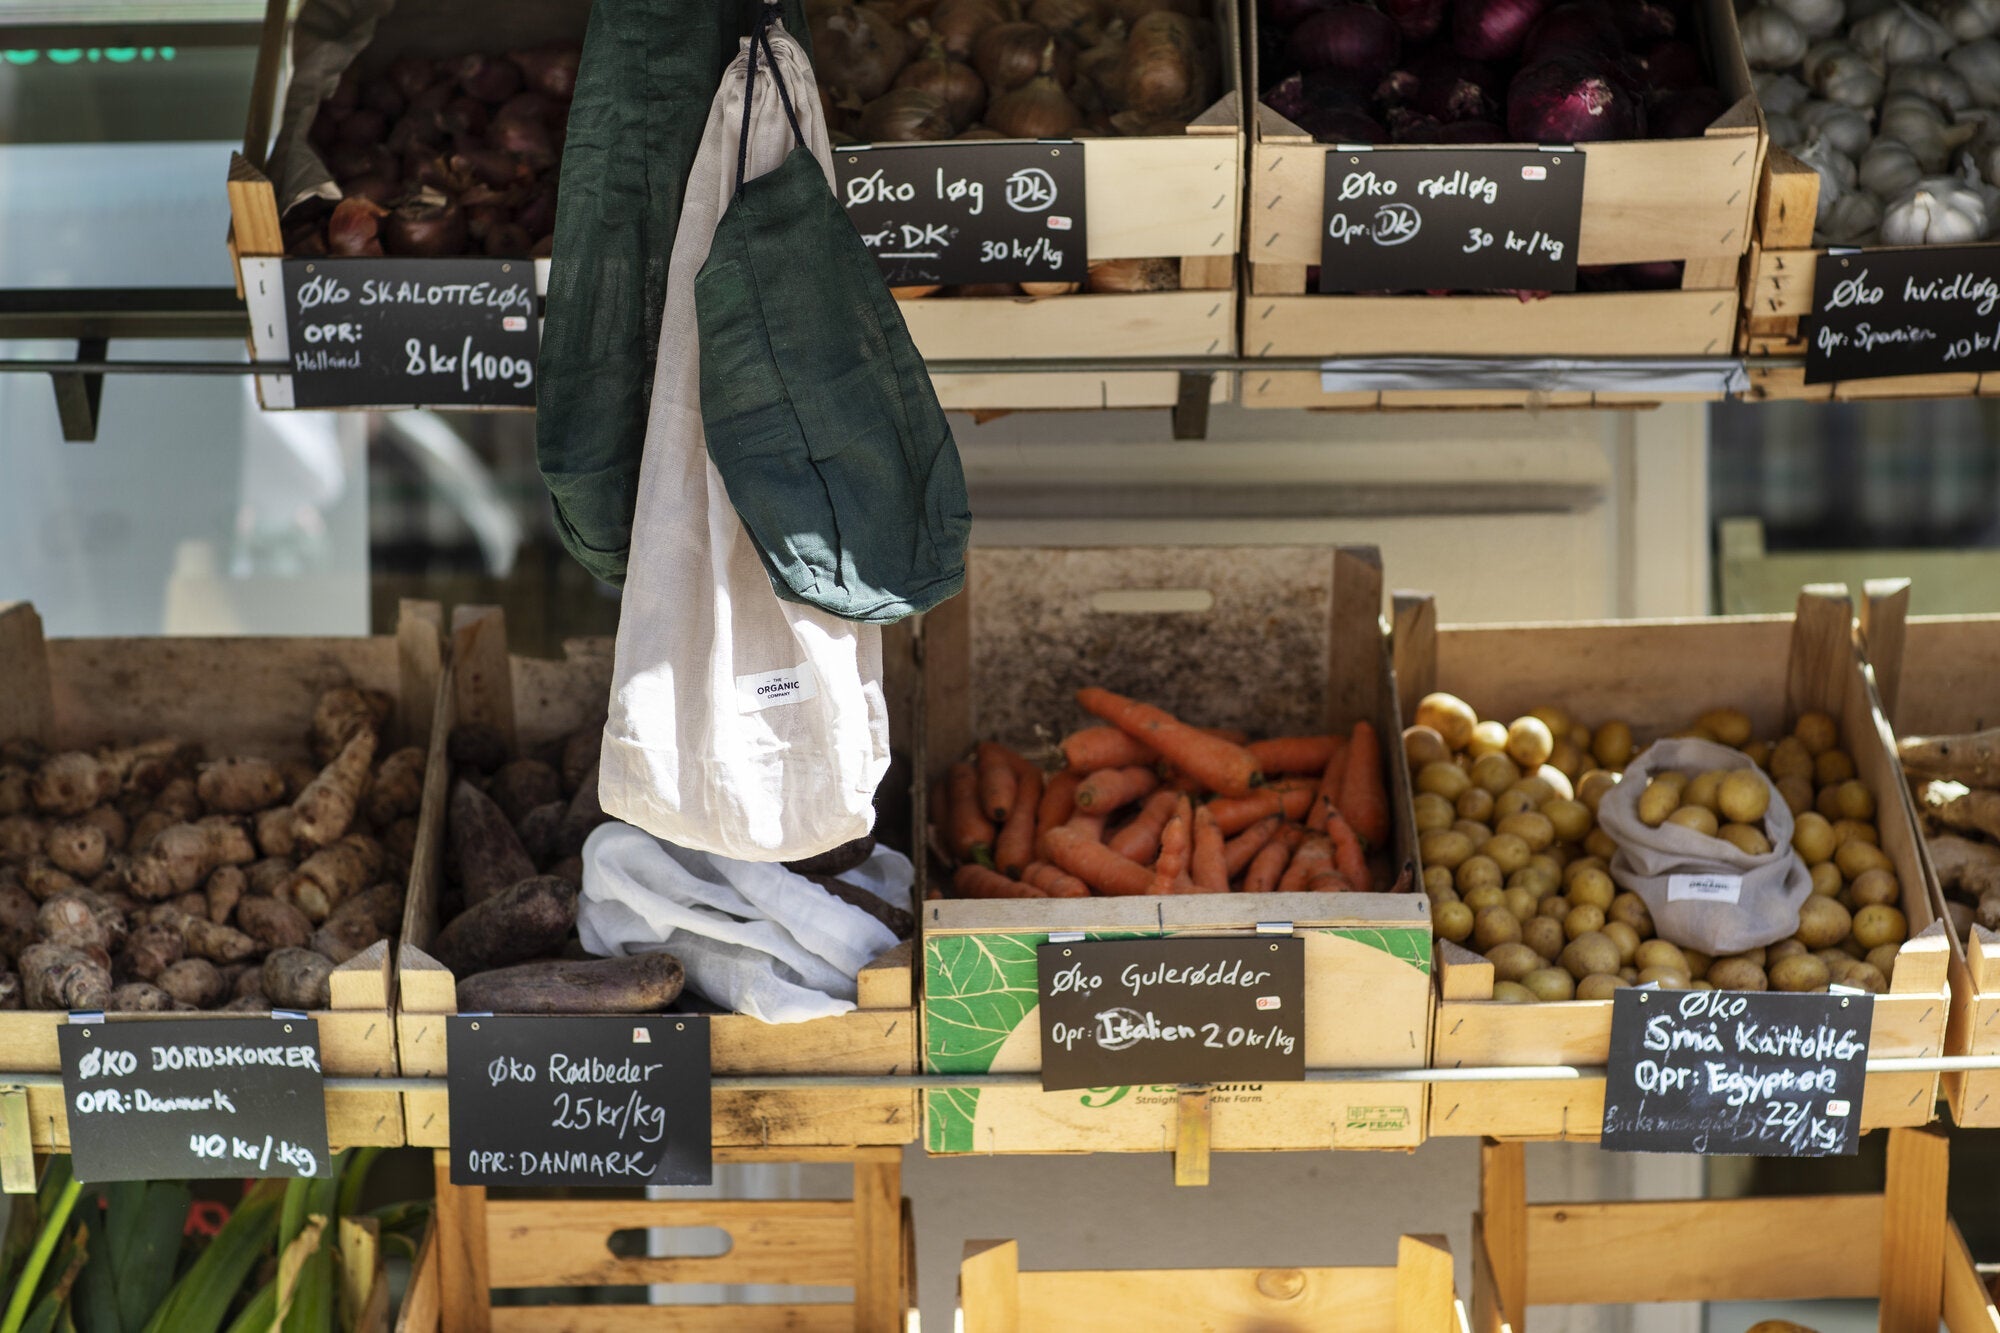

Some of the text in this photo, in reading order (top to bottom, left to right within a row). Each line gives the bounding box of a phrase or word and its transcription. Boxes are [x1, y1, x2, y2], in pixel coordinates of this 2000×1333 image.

[846, 168, 915, 208] Øko
[936, 167, 984, 215] løg
[1338, 169, 1498, 204] Øko rødløg
[1462, 227, 1564, 262] 30 kr/kg
[1823, 268, 2000, 316] Øko hvidløg
[304, 322, 363, 344] OPR:
[1817, 322, 1937, 359] Opr: Spanien
[295, 350, 362, 372] Holland
[757, 681, 800, 695] ORGANIC
[767, 691, 791, 700] COMPANY
[1050, 959, 1271, 997] Øko Gulerødder
[1679, 989, 1748, 1022] Øko
[1643, 1013, 1724, 1054] Små
[79, 1045, 321, 1080] ØKO JORDSKOKKER
[488, 1053, 663, 1087] Øko Rødbeder
[1135, 1095, 1178, 1105] Straigh
[1235, 1093, 1262, 1103] Farm
[1635, 1059, 1837, 1107] Opr: Egypten
[189, 1134, 227, 1158] 40
